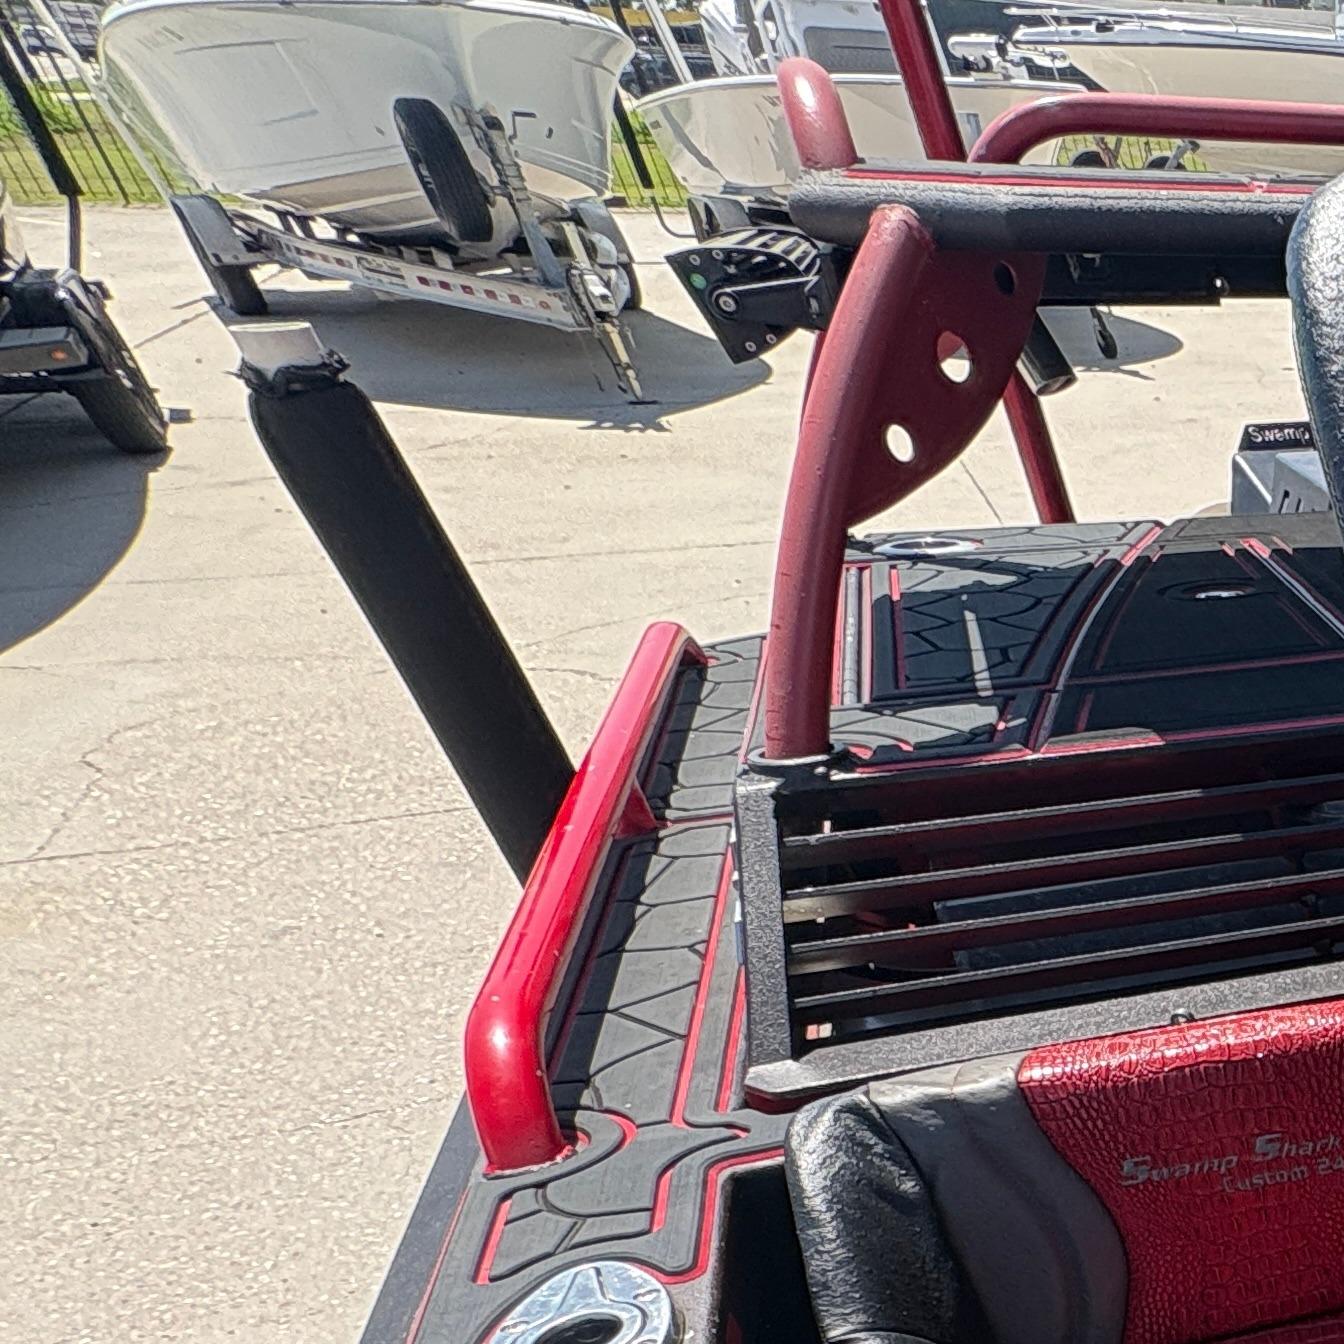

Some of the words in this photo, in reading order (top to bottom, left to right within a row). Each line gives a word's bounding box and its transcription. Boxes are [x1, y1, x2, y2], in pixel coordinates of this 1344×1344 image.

[1120, 1154, 1239, 1186] Swamp
[1252, 1133, 1343, 1162] Shark
[1223, 1166, 1309, 1193] Custom
